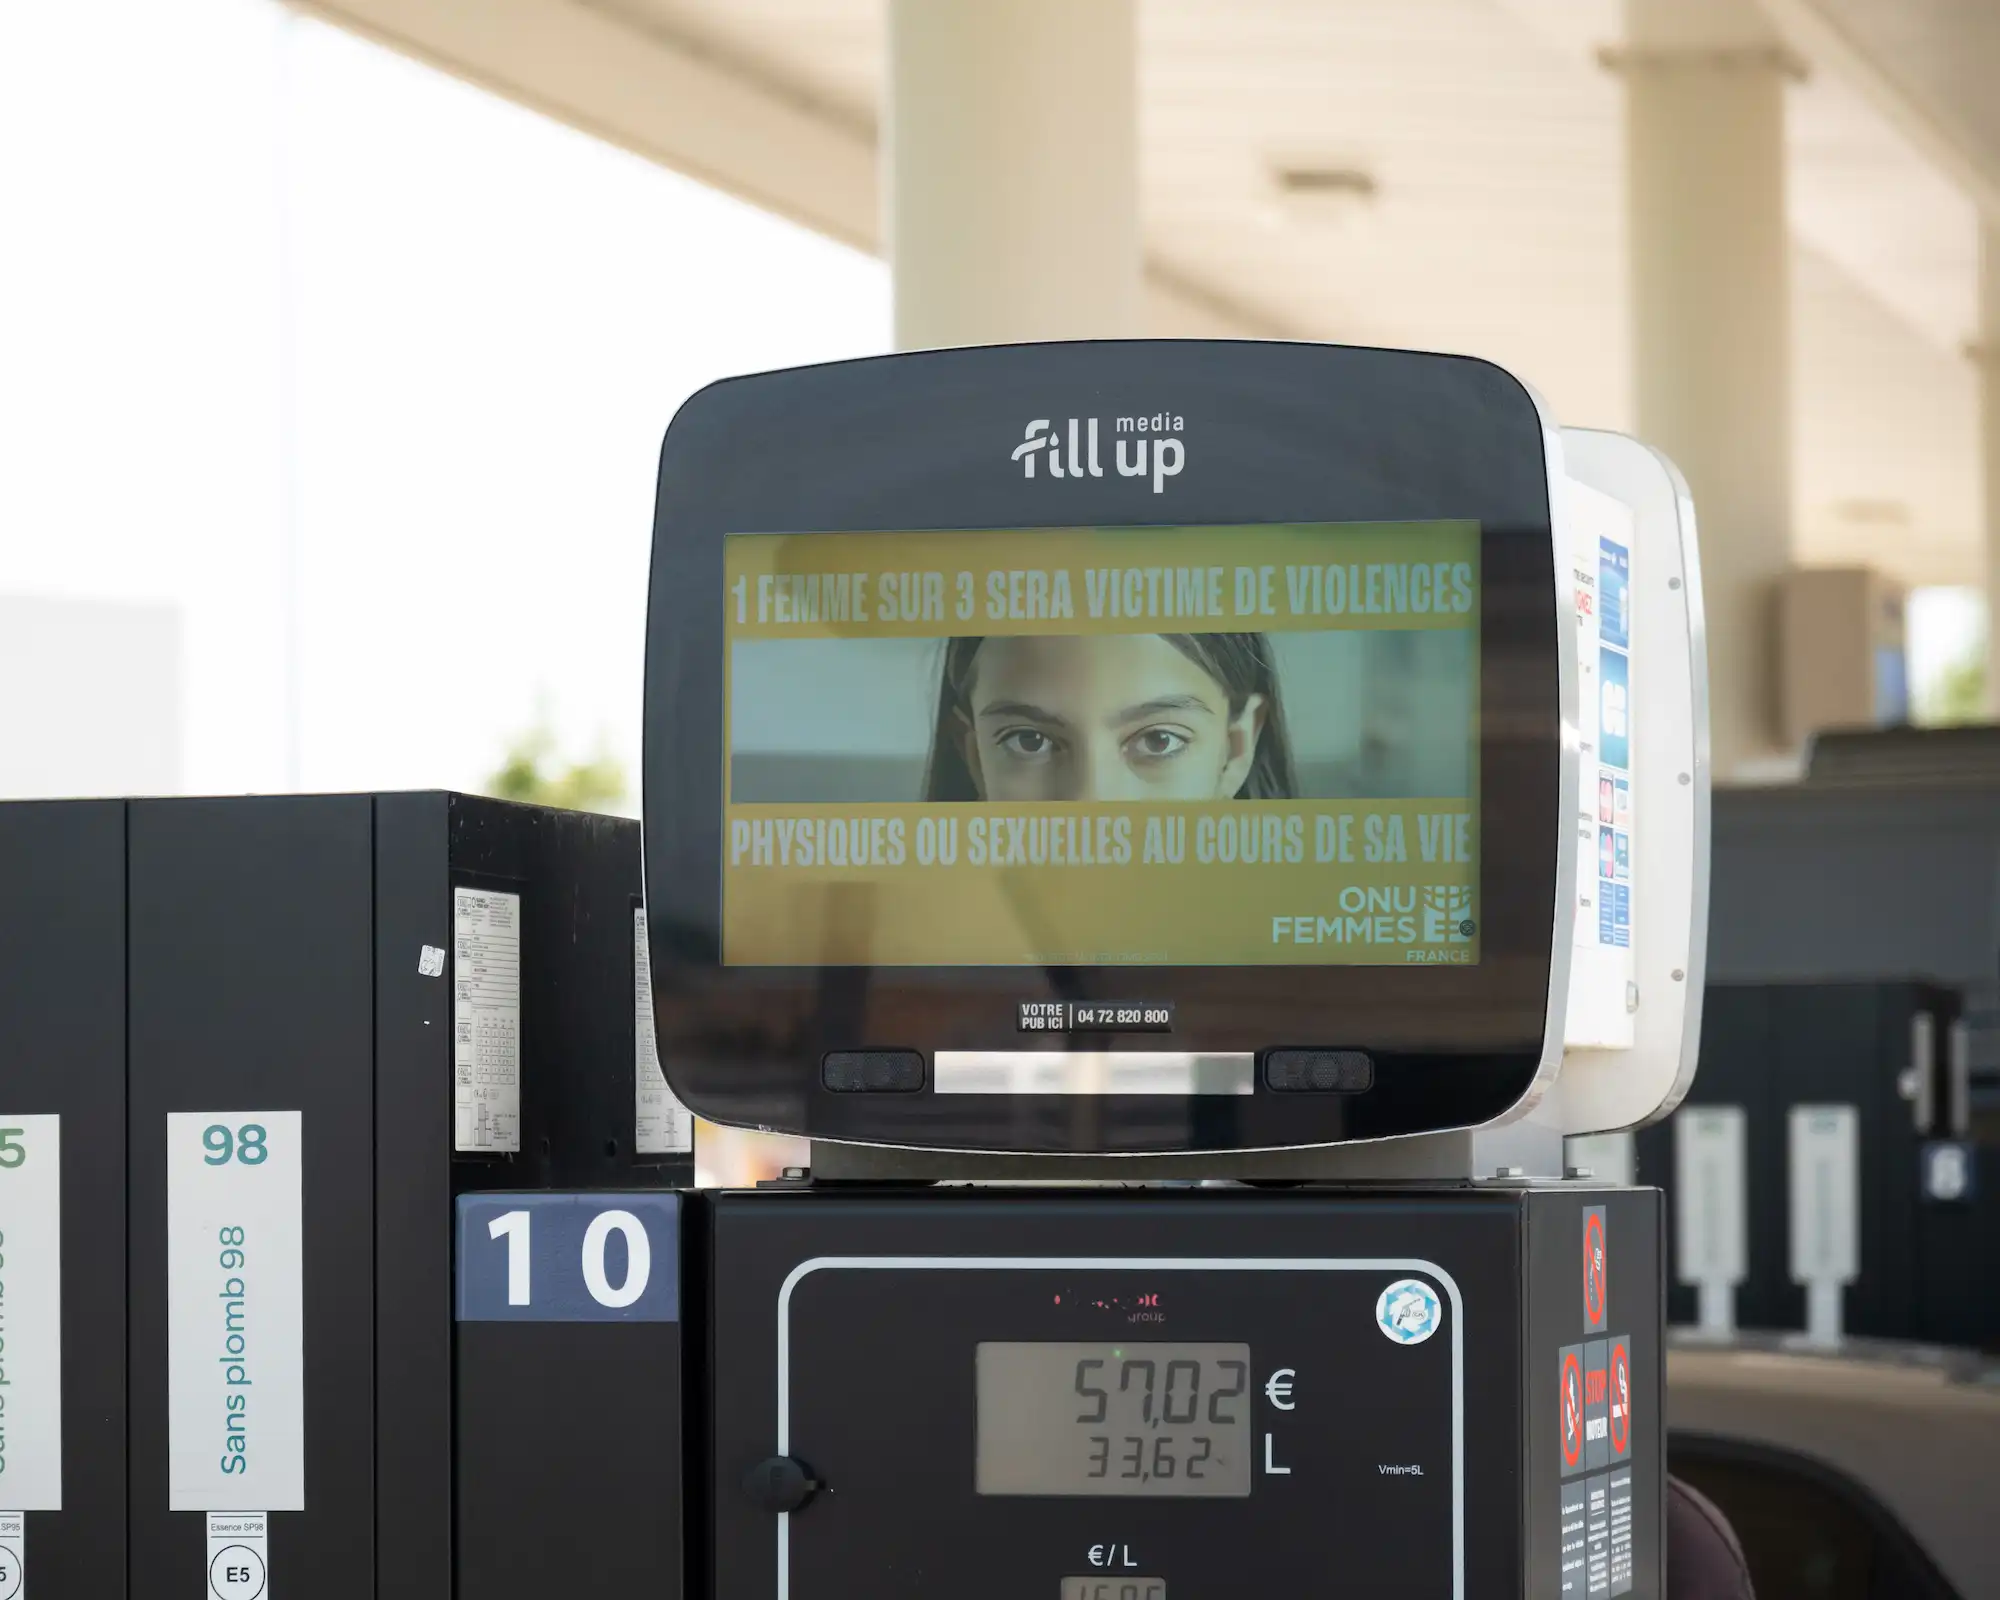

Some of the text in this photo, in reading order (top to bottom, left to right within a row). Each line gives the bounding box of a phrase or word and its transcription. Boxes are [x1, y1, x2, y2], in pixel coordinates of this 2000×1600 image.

[1116, 412, 1184, 432] media
[1011, 418, 1186, 494] fill up
[731, 562, 1473, 624] 1 FEMME SUR 3 SERA VICTIME DE VIOLENCES
[730, 813, 1471, 867] PHYSIQUES OU SEXUELLES AU COURS DE SA VIE
[1338, 885, 1417, 914] ONU
[1272, 916, 1417, 944] FEMMES
[1405, 950, 1470, 963] FRANCE
[1022, 1004, 1063, 1016] VOTRE
[1022, 1017, 1063, 1029] PUB ICI
[1077, 1009, 1169, 1023] 04 72 820 800
[202, 1124, 268, 1166] 98
[218, 1225, 252, 1475] Sans plomb 98
[1075, 1360, 1247, 1429] 57,02
[1264, 1368, 1296, 1411] €
[1086, 1436, 1212, 1484] 33,62
[1264, 1433, 1292, 1474] L
[1378, 1464, 1425, 1476] Vmin=5L
[1, 1522, 21, 1532] SP95
[210, 1522, 264, 1532] Essence SP98
[226, 1566, 251, 1583] E5
